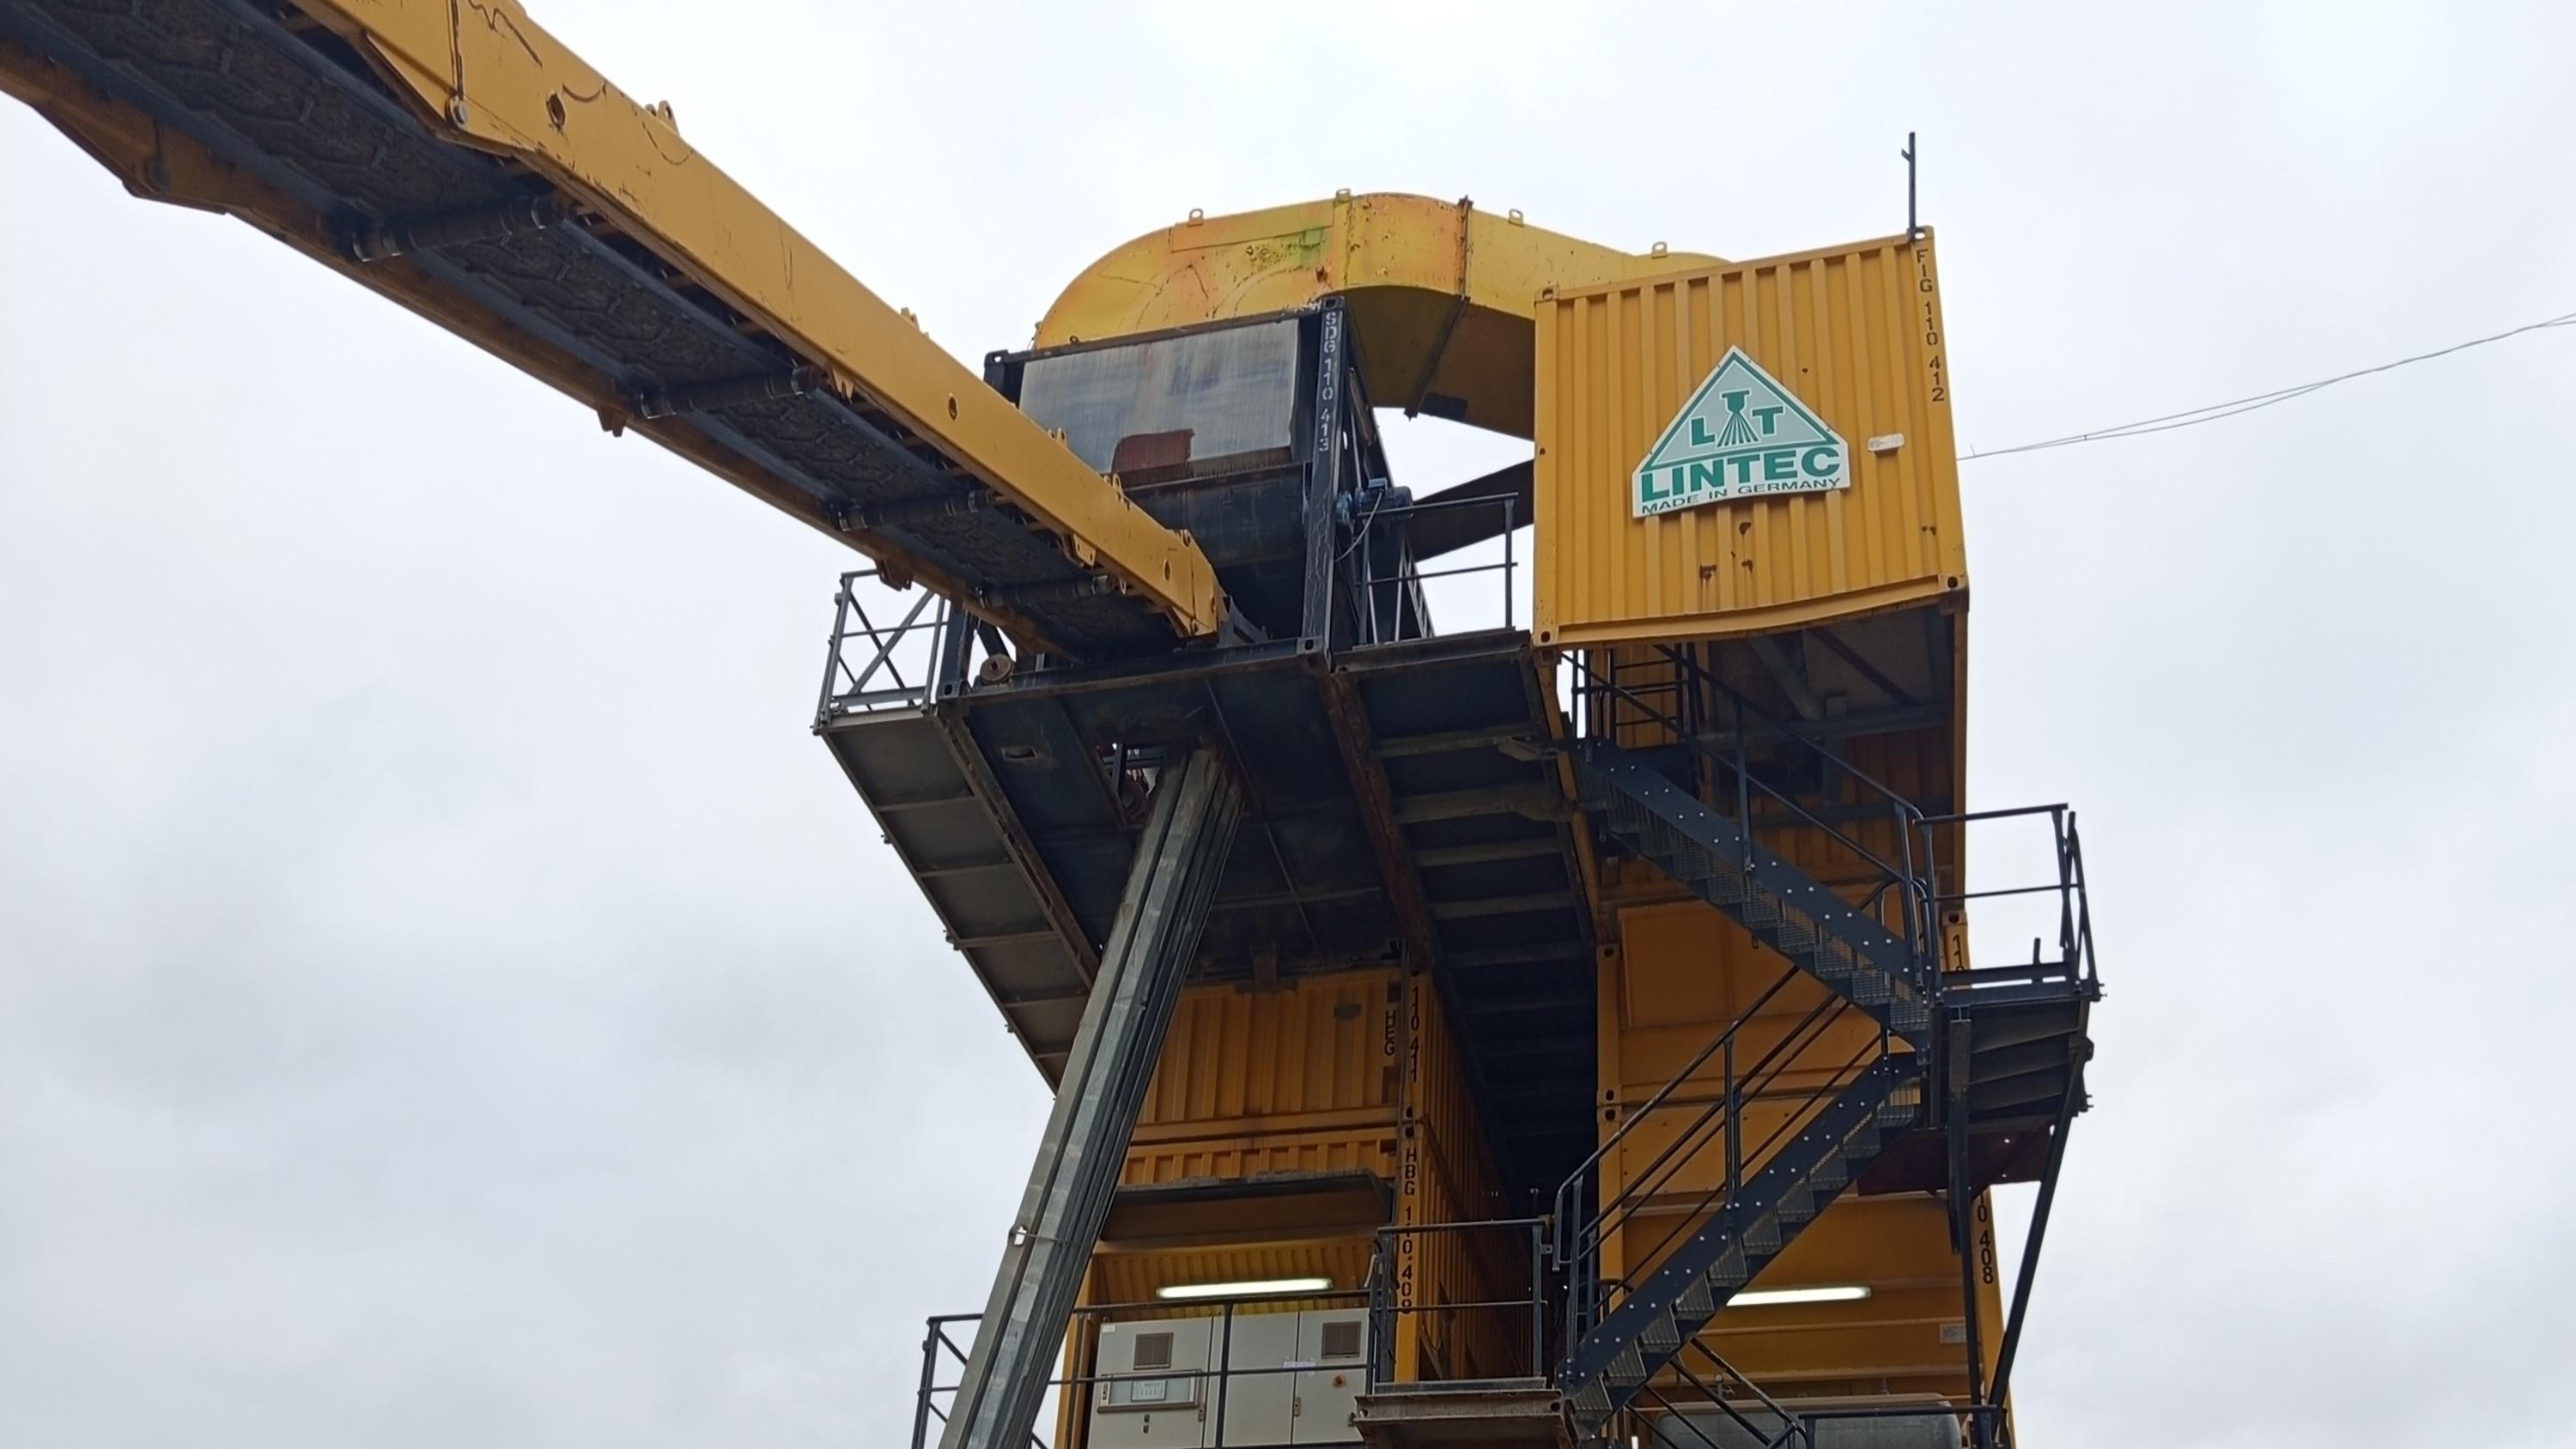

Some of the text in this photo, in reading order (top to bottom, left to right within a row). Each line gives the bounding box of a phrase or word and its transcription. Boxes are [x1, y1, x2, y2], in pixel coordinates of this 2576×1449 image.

[1916, 248, 1945, 402] FIG 110 412
[1318, 312, 1337, 452] SDG 110 413
[1641, 446, 1841, 503] LINTEC
[1641, 477, 1841, 514] MADE IN GERMANY
[1952, 934, 1965, 971] 11
[1384, 1009, 1396, 1056] HEG
[1409, 985, 1420, 1083] 110 411
[1404, 1148, 1417, 1196] HBG
[1978, 1229, 1994, 1284] 408
